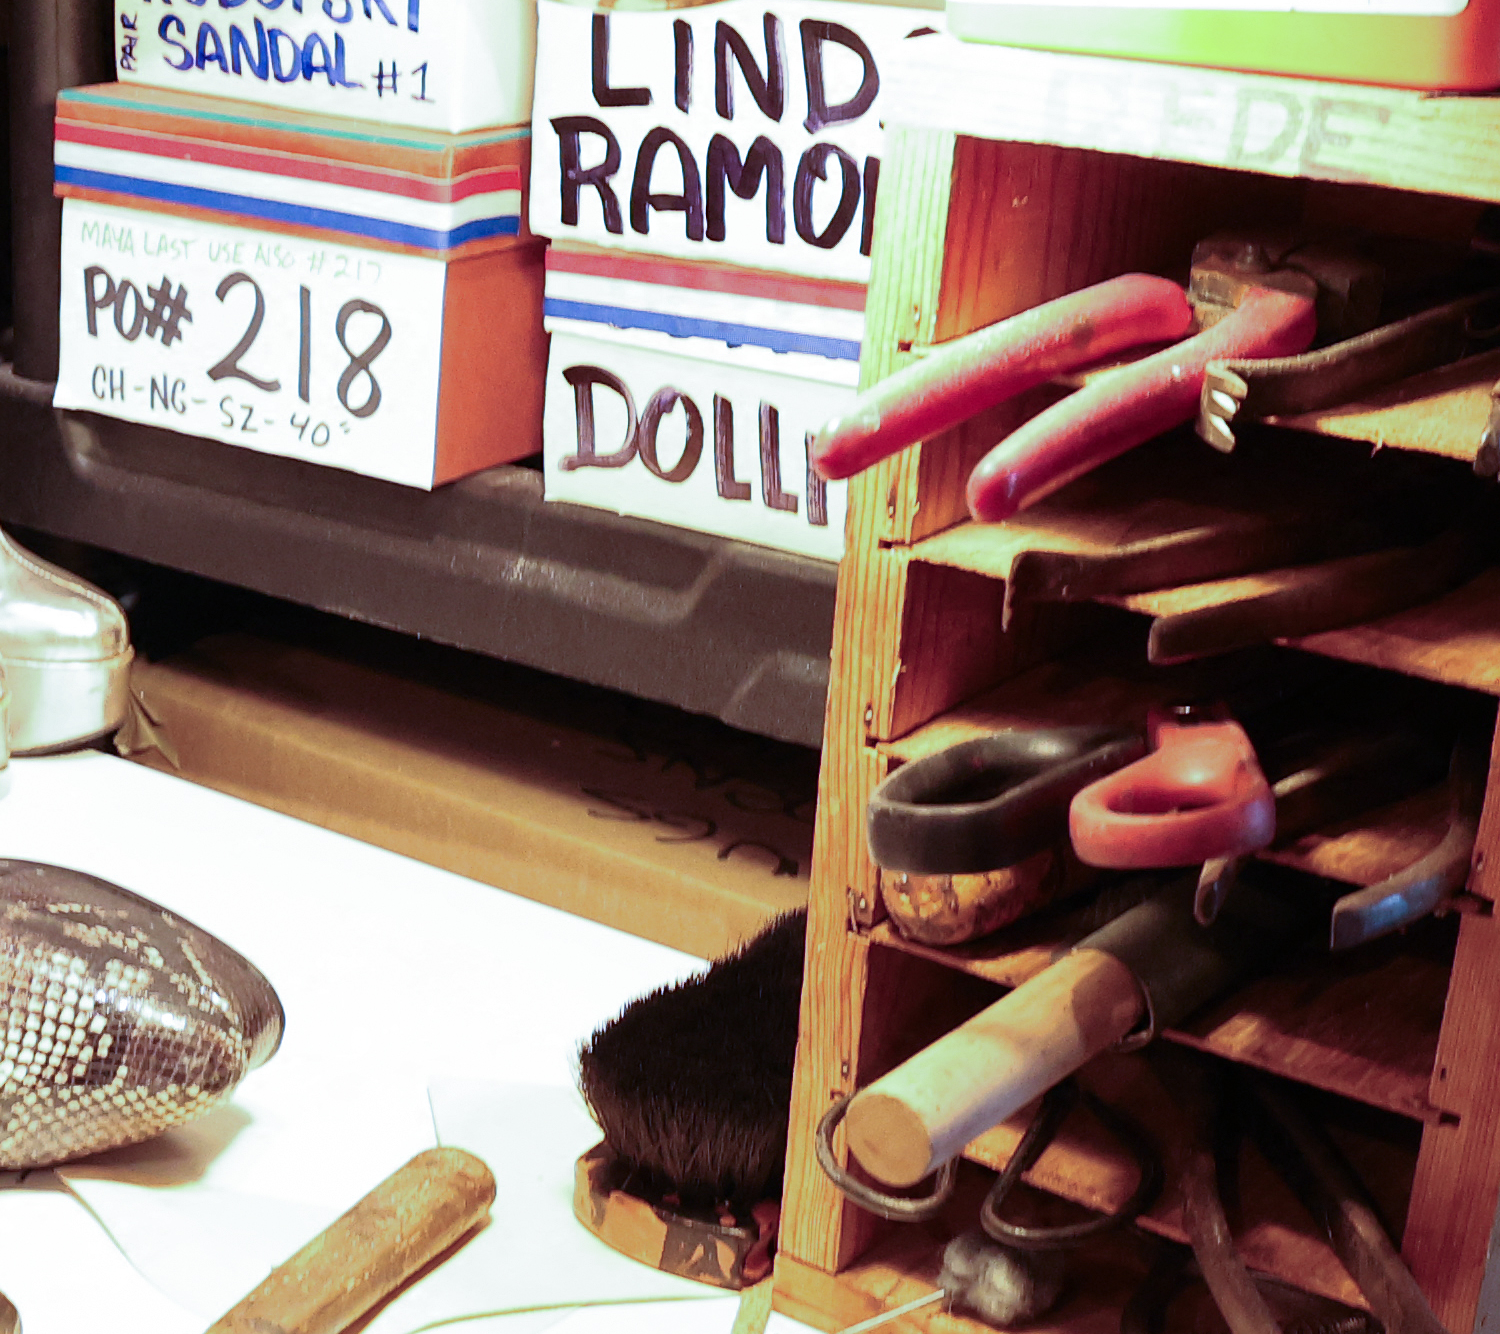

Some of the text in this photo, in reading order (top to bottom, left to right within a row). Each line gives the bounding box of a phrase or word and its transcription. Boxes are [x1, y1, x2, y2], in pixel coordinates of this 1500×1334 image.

[158, 14, 365, 89] SANDAL
[81, 221, 134, 257] MAYA
[144, 233, 197, 260] LAST
[210, 242, 245, 264] USE
[84, 265, 392, 418] PO# 218
